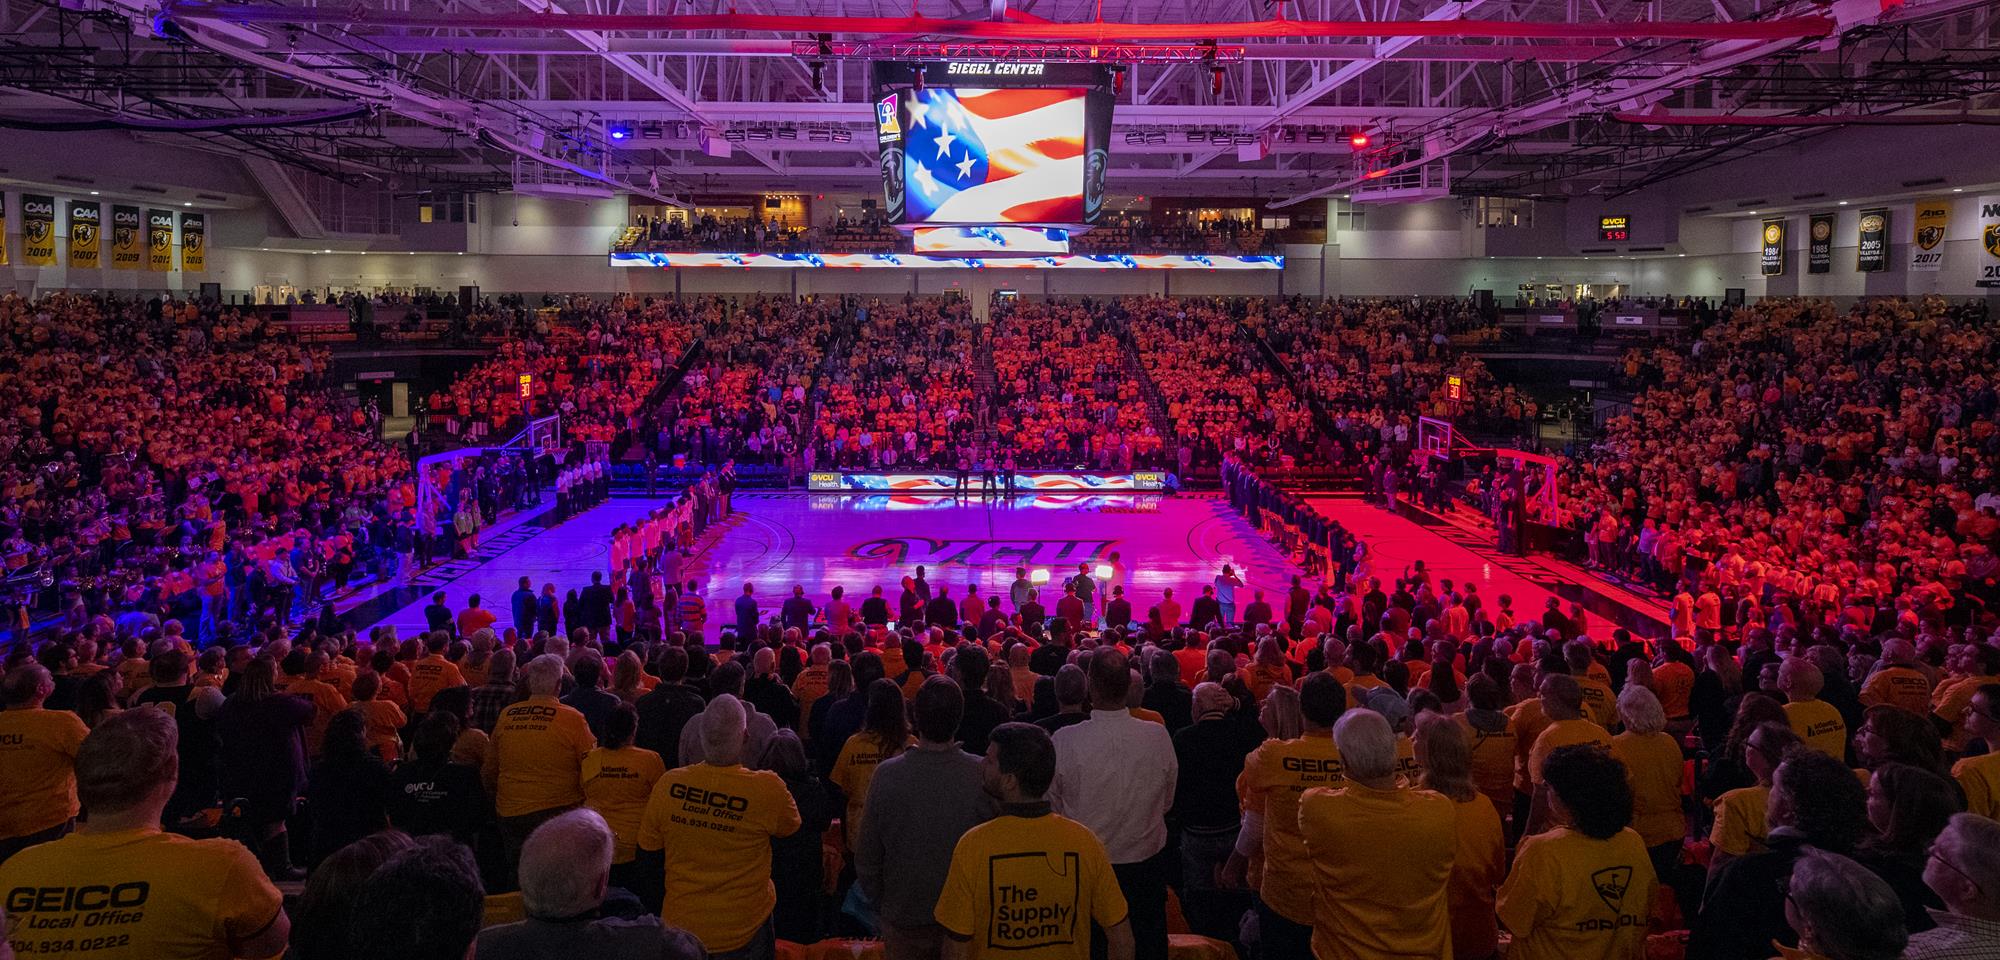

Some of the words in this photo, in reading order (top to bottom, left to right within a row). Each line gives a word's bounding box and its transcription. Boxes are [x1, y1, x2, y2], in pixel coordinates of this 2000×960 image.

[947, 62, 991, 75] SIEGEL
[994, 62, 1044, 75] CENTER
[24, 201, 53, 214] CAA
[73, 207, 98, 219] CAA
[115, 212, 138, 223] CAA
[151, 215, 172, 226] CAA
[1862, 240, 1881, 250] 2005
[115, 253, 139, 262] 2009
[1914, 253, 1942, 263] 2017
[522, 383, 530, 396] 30
[1450, 385, 1459, 398] 30
[507, 705, 557, 717] GEICO
[601, 765, 628, 773] Atlantic
[1282, 757, 1343, 773] GEIC
[1301, 773, 1327, 782] Local
[670, 783, 748, 812] GEICO
[682, 802, 711, 815] Local
[712, 808, 744, 821] Office
[6, 880, 150, 912] GEICO
[998, 885, 1038, 903] The
[28, 913, 79, 929] Local
[83, 910, 144, 928] Office
[998, 903, 1071, 925] Supply
[997, 923, 1060, 940] Room
